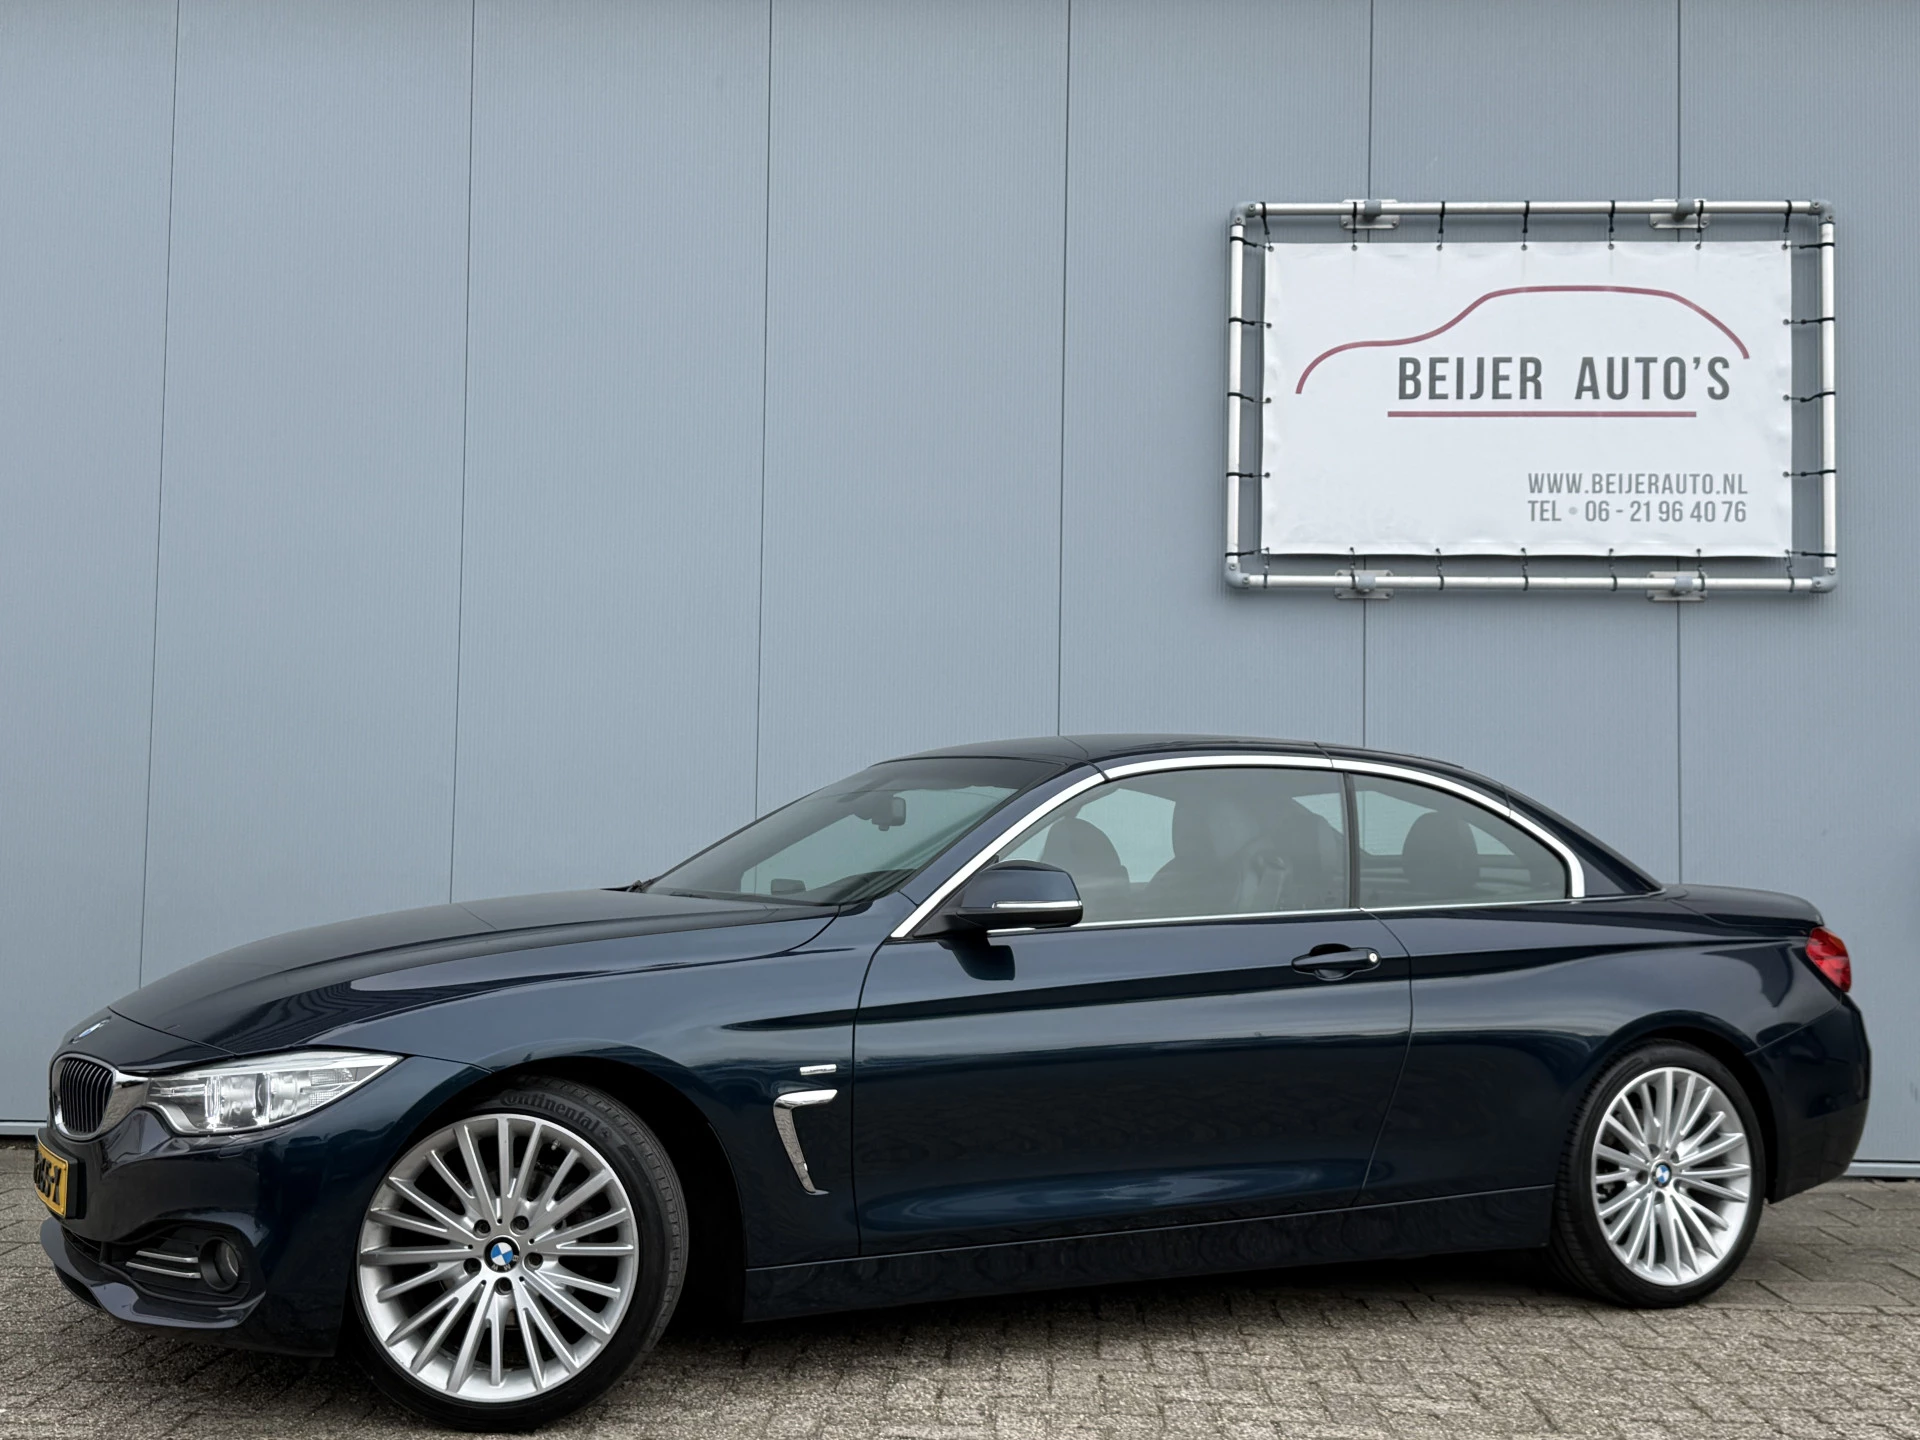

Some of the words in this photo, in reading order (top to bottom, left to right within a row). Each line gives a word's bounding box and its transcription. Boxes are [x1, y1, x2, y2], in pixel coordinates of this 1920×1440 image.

[1398, 356, 1543, 401] BEIJER
[1574, 356, 1730, 401] AUTO’S
[1527, 472, 1749, 495] WWW.BEIJERAUTO.NL
[1527, 499, 1562, 522] TEL
[1585, 500, 1610, 523] 06
[1689, 500, 1716, 523] 40
[1721, 500, 1747, 523] 76
[500, 1091, 600, 1133] Continental
